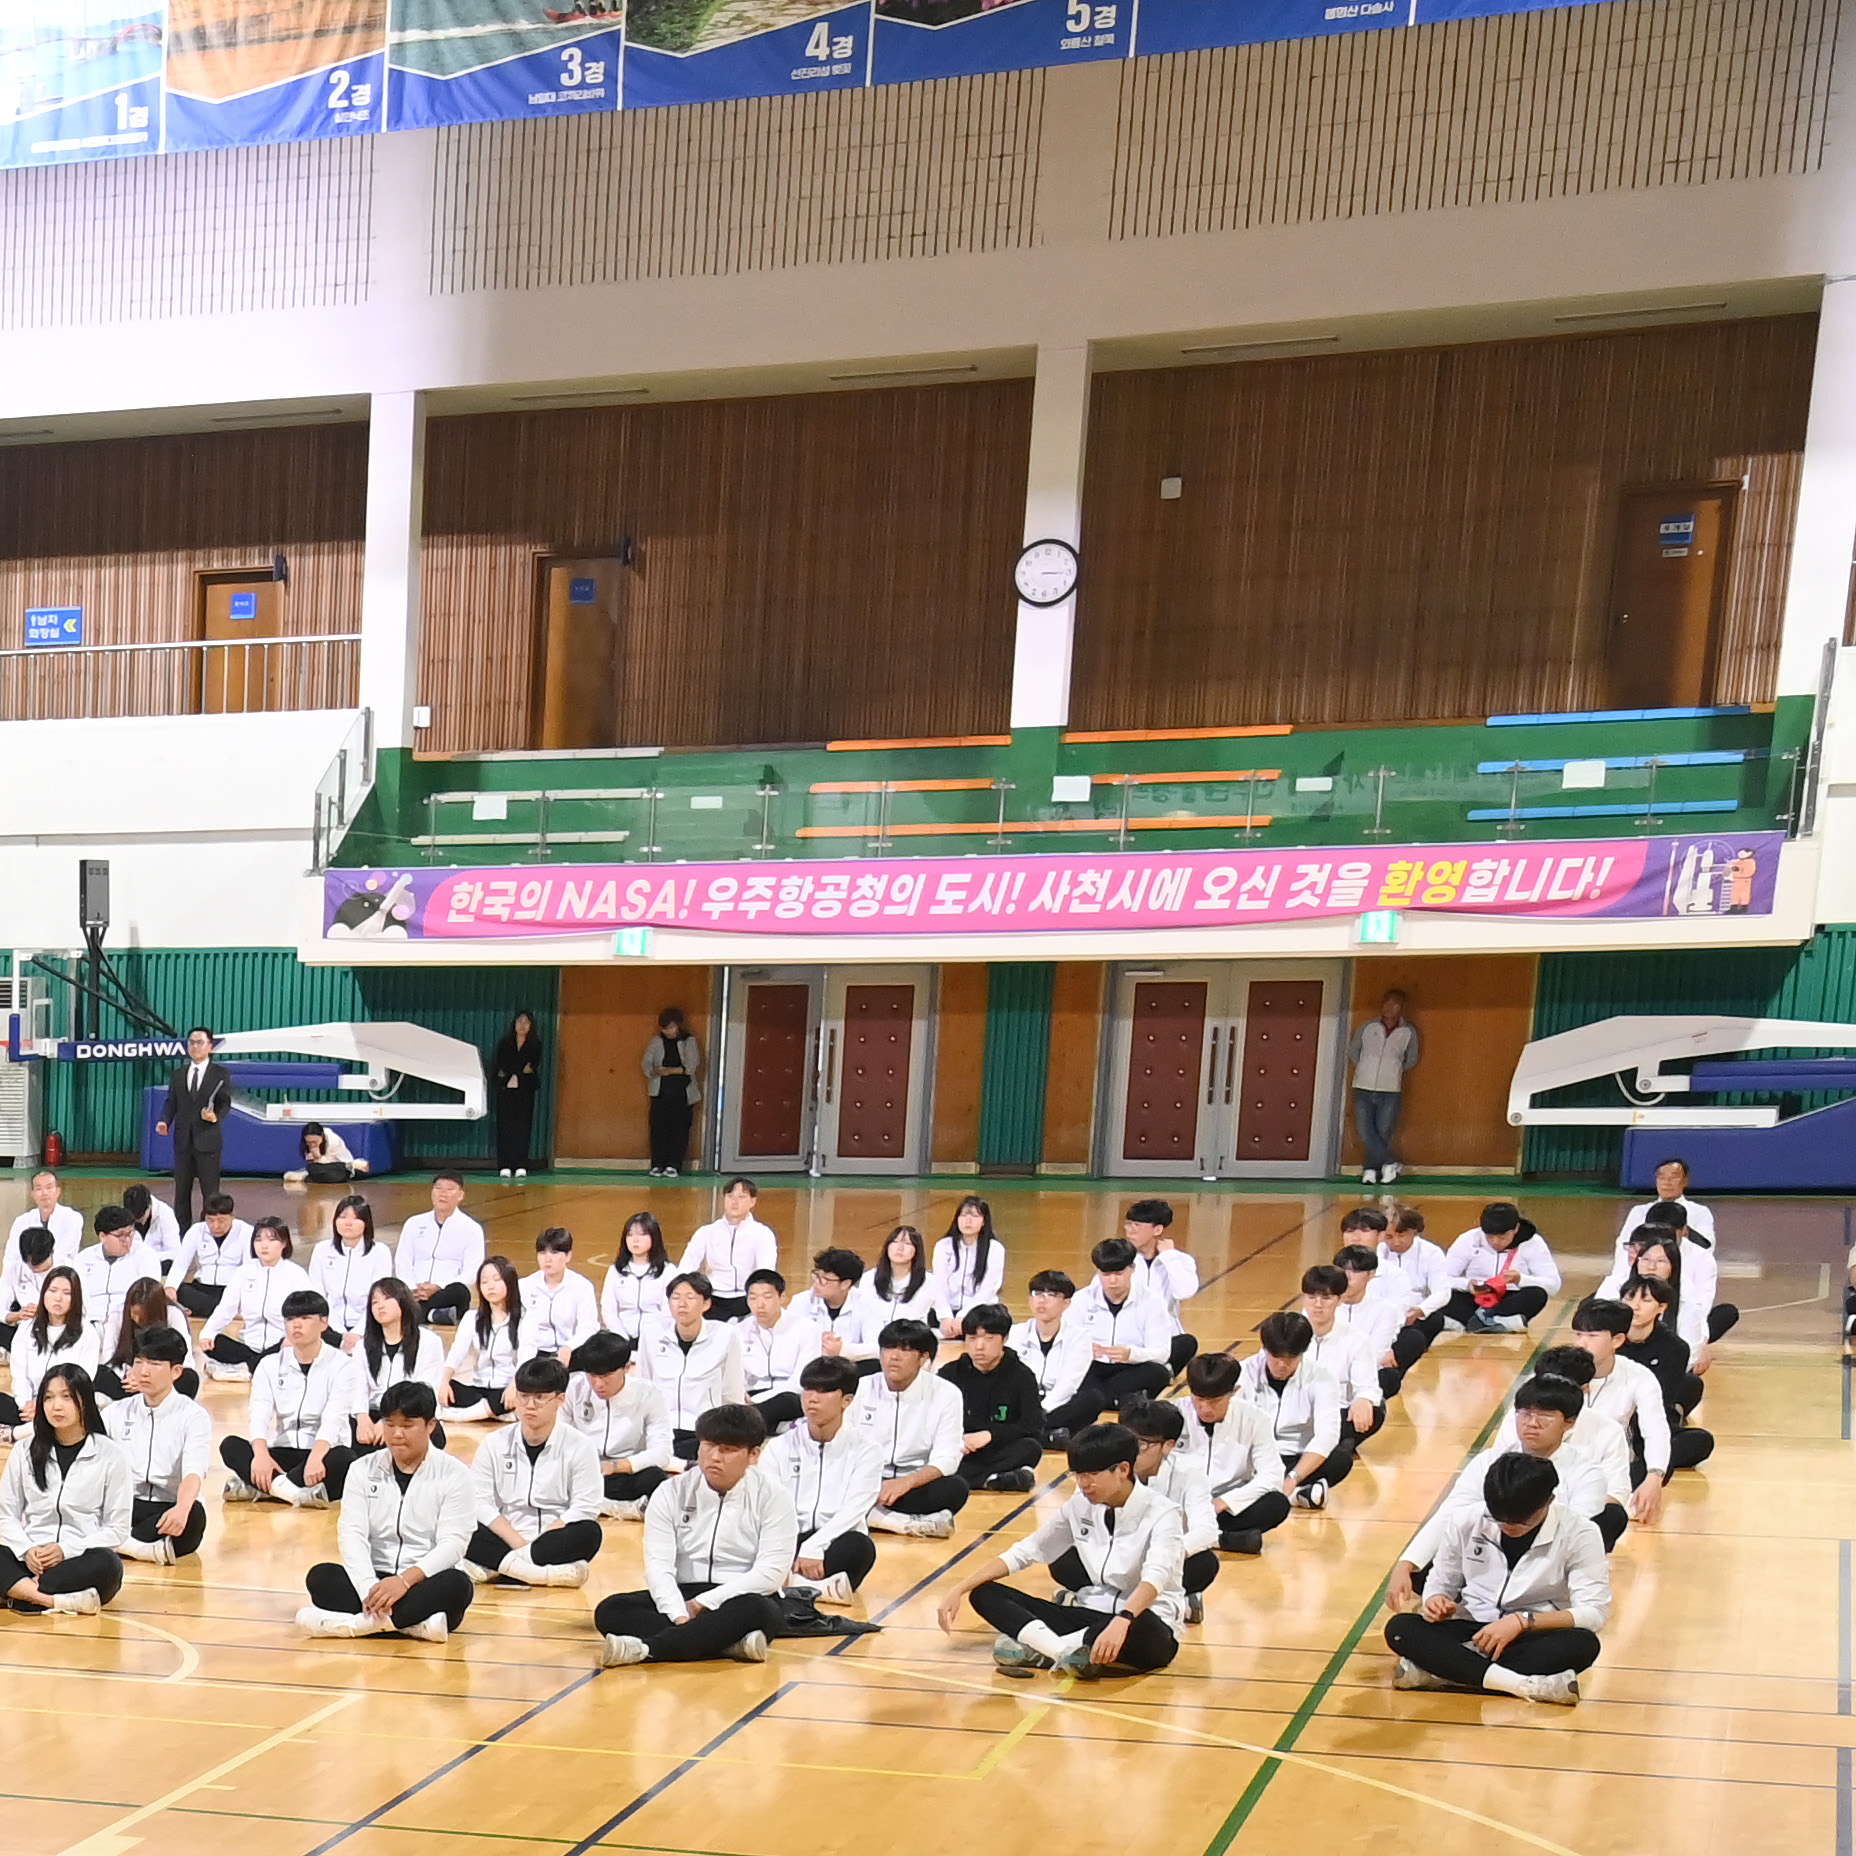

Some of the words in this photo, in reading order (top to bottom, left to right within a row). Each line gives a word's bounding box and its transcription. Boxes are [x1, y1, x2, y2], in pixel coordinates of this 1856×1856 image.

[1066, 0, 1117, 33] 5경
[805, 21, 854, 61] 4경
[559, 47, 605, 87] 3경
[327, 69, 371, 109] 2경
[114, 92, 149, 130] 1경
[447, 880, 552, 923] 한국의
[556, 879, 698, 920] NASA!
[701, 873, 927, 919] 우주항공청의
[929, 871, 1026, 915] 도시!
[1028, 867, 1193, 914] 사천시에
[1194, 865, 1282, 910] 오신
[1285, 861, 1372, 908] 것을
[1377, 856, 1615, 907] 환영합니다!
[76, 1042, 186, 1059] DONGHWA
